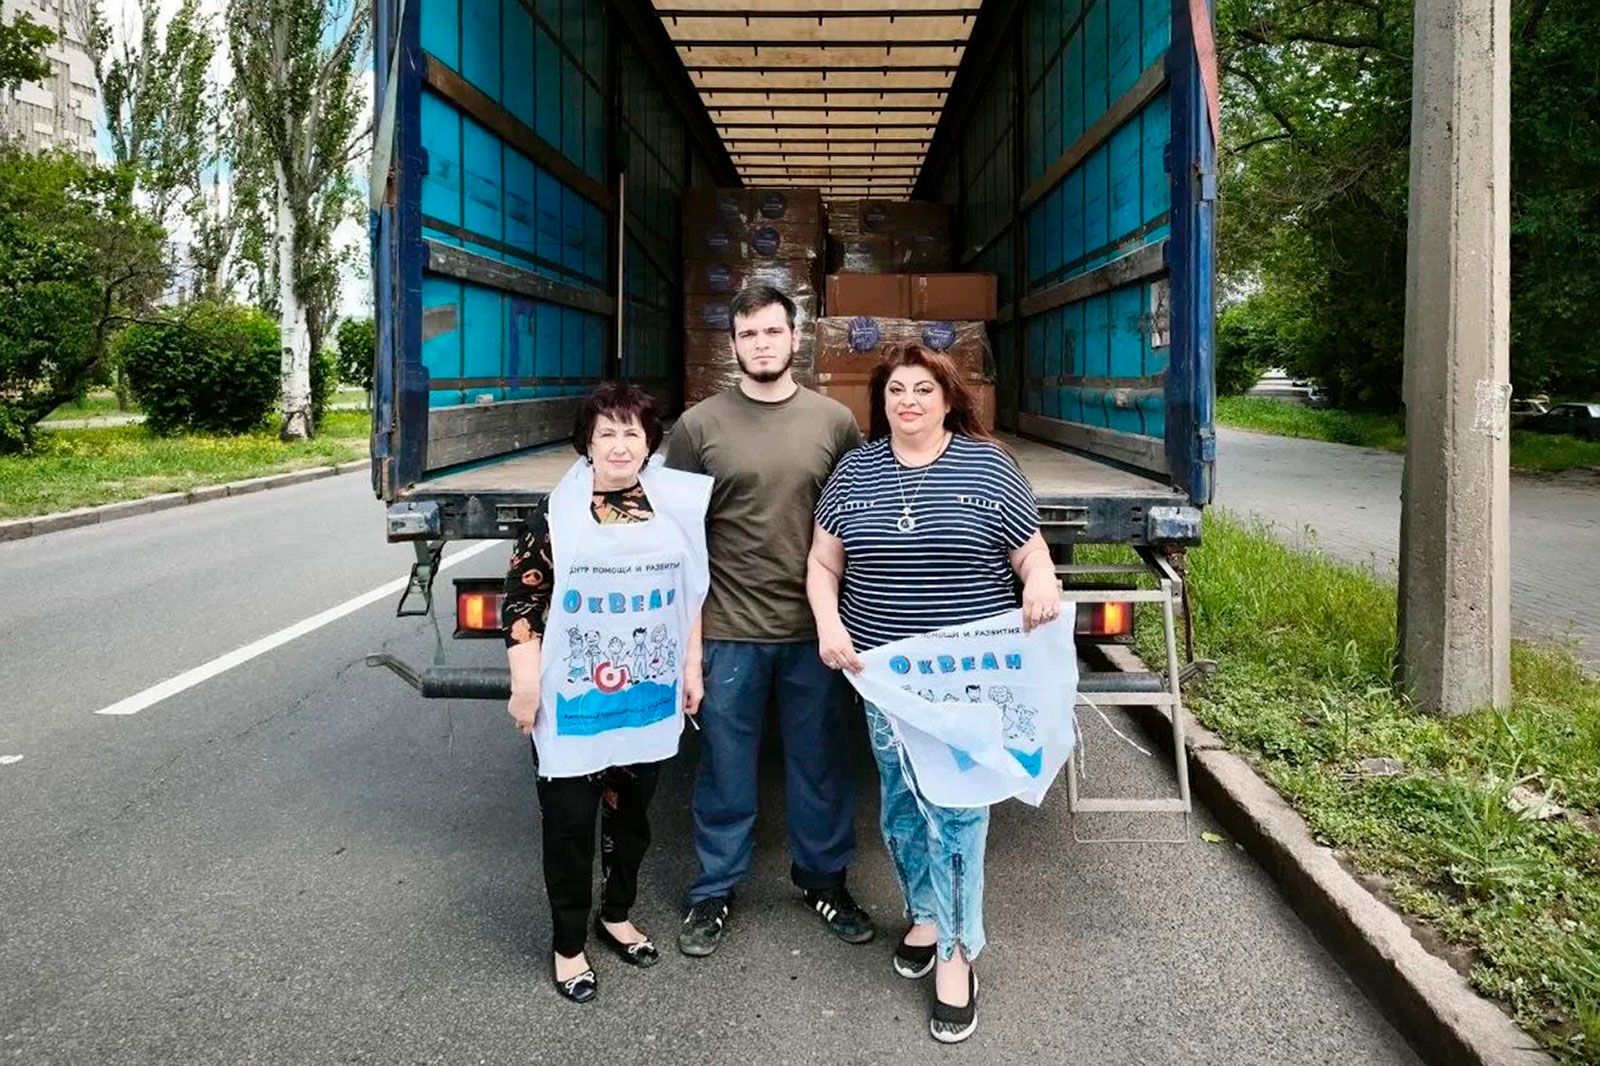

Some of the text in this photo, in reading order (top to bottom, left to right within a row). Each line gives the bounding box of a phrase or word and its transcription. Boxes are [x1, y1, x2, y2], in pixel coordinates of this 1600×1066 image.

[592, 565, 632, 574] ПОМОЩИ
[635, 565, 642, 573] И
[646, 562, 680, 571] РАЗВИТИ
[975, 627, 1020, 637] РАЗВИТИЯ
